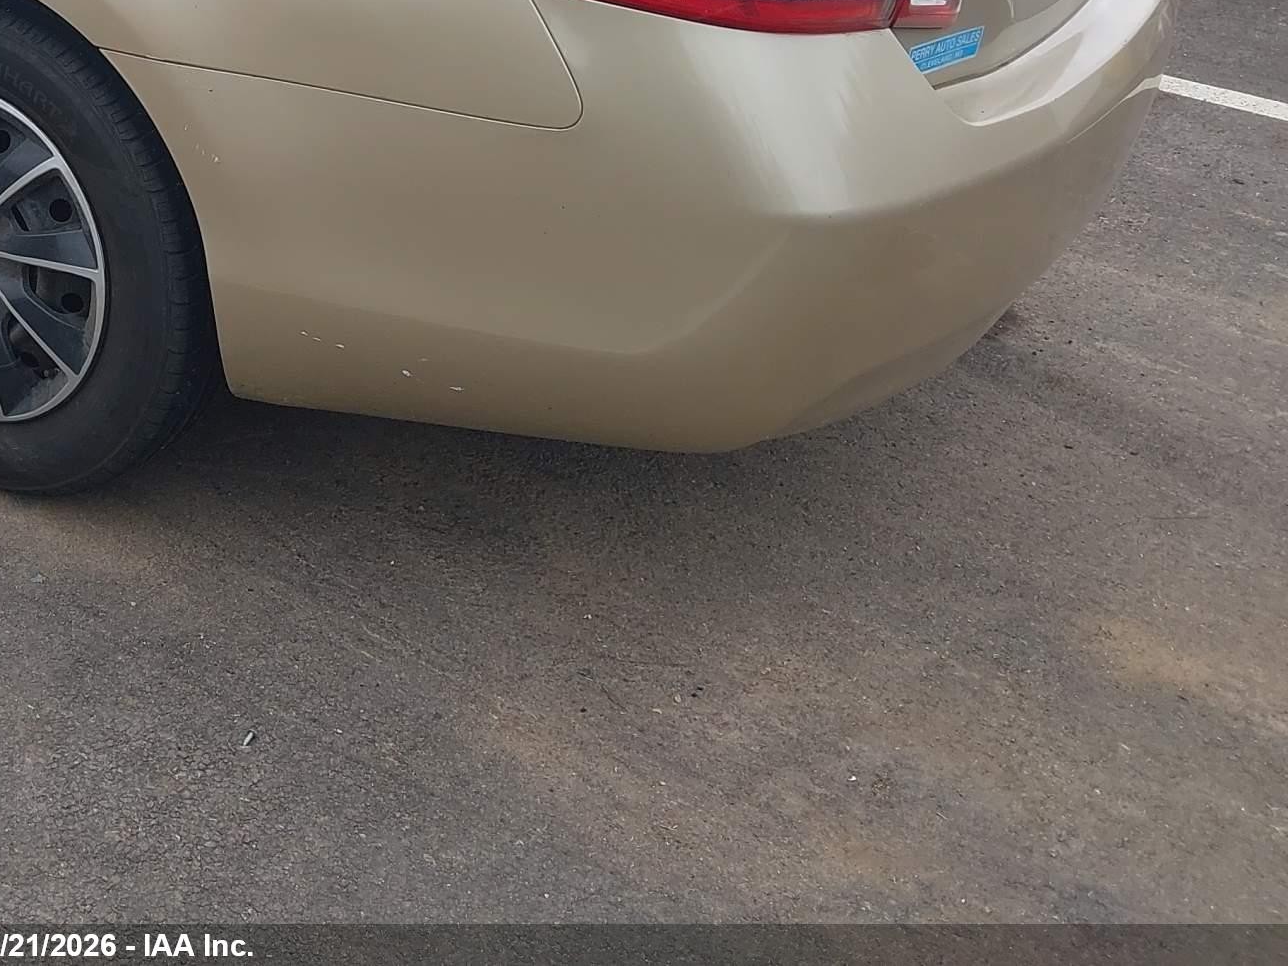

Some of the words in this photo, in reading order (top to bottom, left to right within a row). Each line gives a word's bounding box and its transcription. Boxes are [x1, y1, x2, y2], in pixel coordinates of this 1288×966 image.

[912, 42, 936, 61] PERRY
[935, 37, 957, 53] AUTO
[956, 31, 981, 47] SALES
